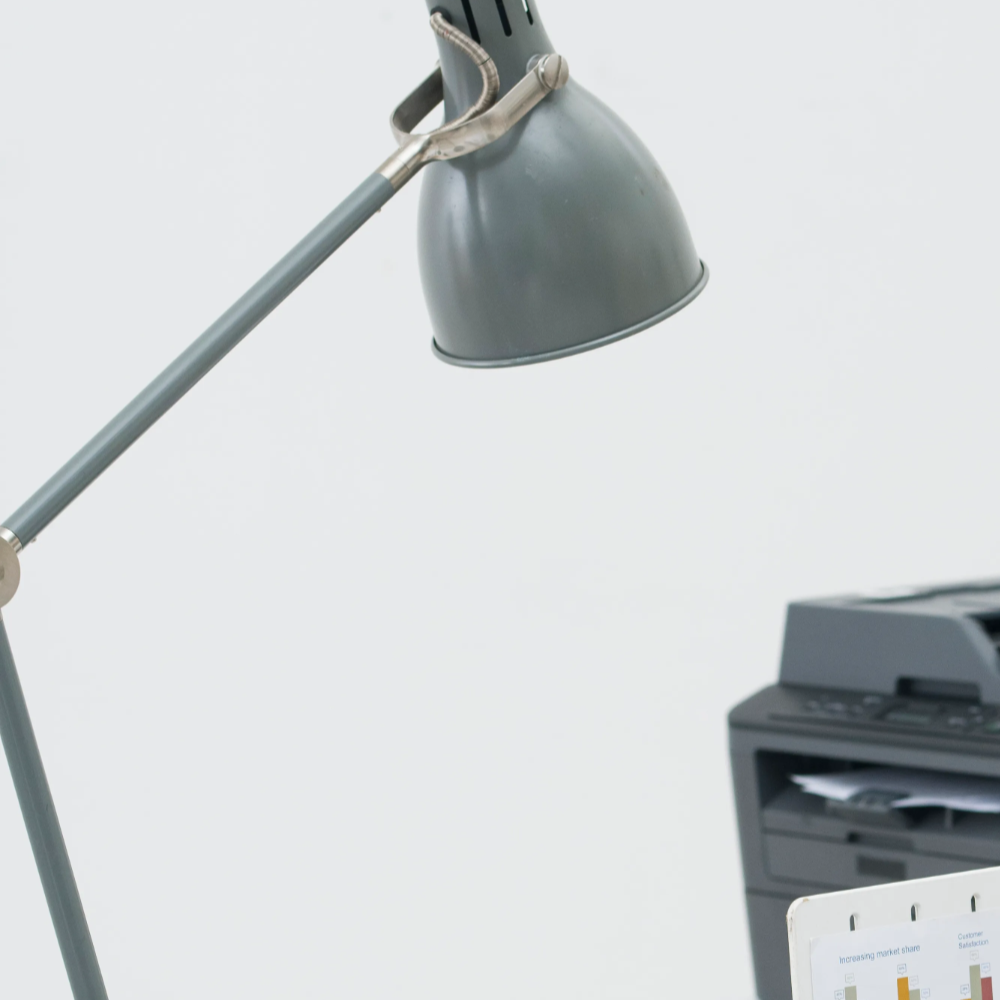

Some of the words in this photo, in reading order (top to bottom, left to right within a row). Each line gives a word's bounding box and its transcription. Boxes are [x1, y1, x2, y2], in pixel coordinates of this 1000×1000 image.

[958, 931, 984, 940] Customer
[958, 938, 989, 950] Satisfaction
[839, 952, 875, 964] Increasing
[876, 948, 900, 958] market
[902, 944, 920, 954] share
